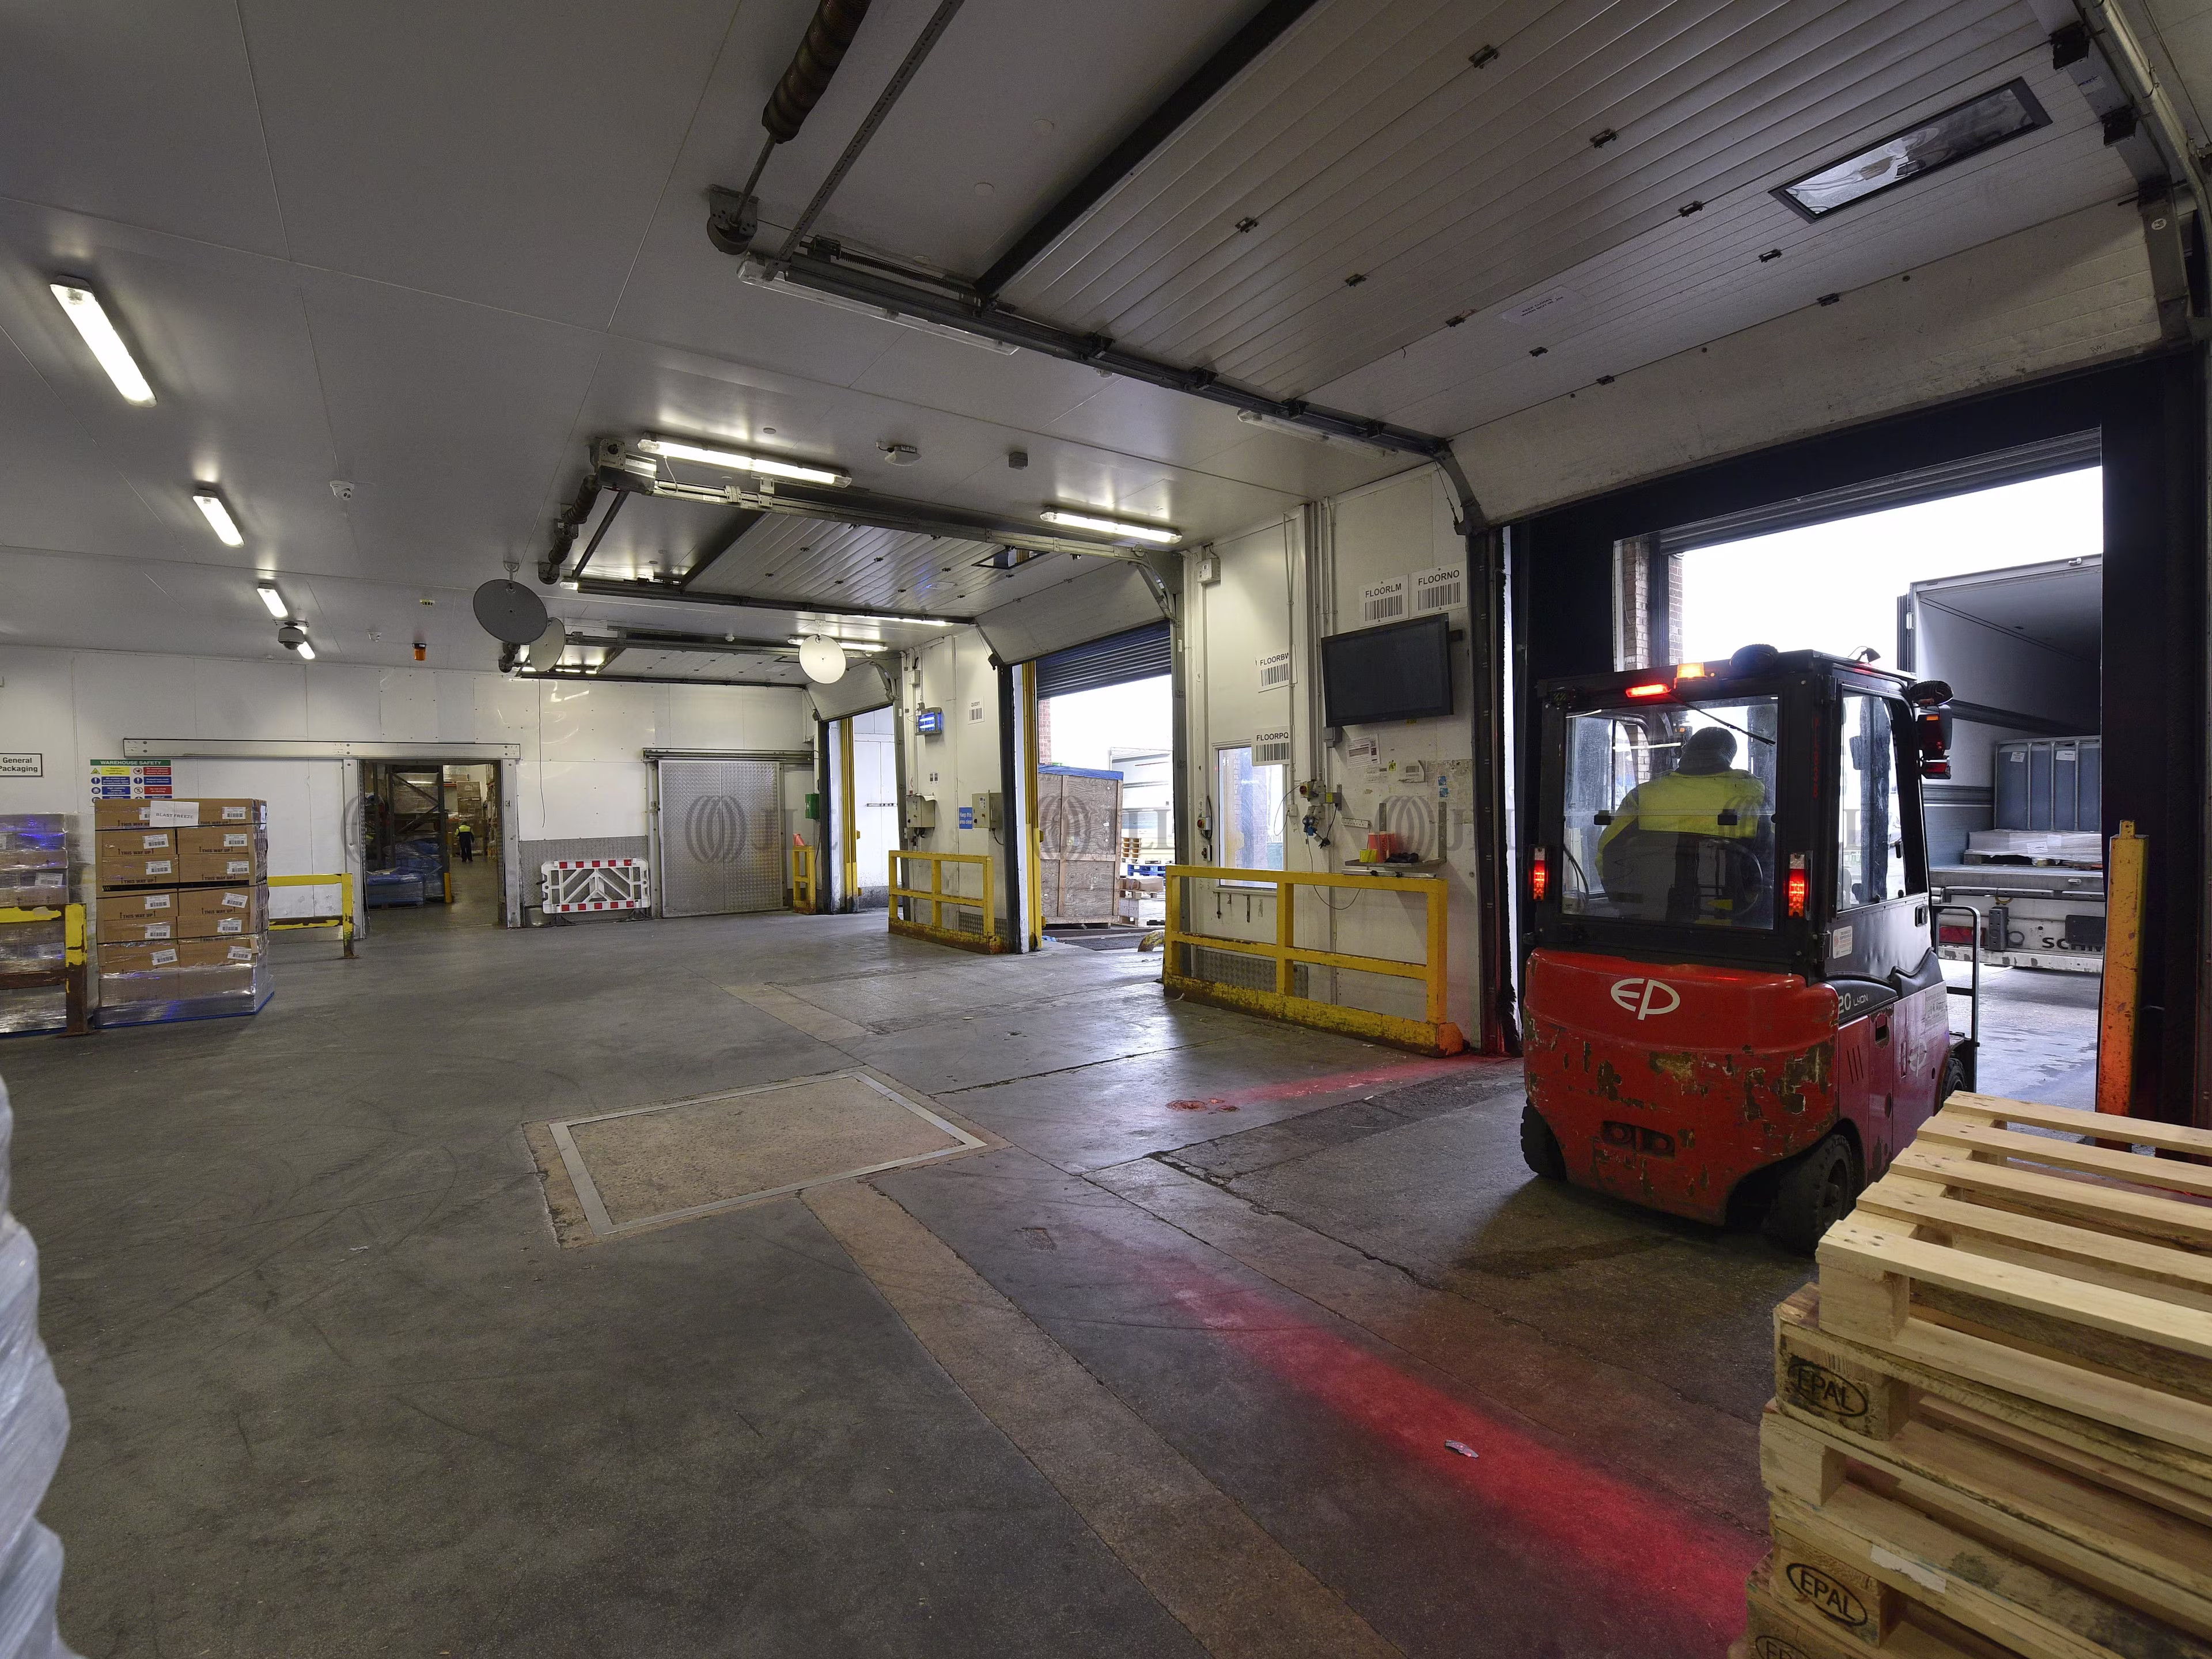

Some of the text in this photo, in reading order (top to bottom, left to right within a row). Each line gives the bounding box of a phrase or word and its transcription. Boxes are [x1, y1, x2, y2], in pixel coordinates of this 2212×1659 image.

[1365, 583, 1402, 599] FLOORLM
[1418, 570, 1460, 586] FLOORNO
[1256, 732, 1289, 741] FLOORPQ
[1611, 978, 1681, 1021] EP
[1798, 1368, 1855, 1412] EPAL
[1800, 1569, 1855, 1622] EPAL
